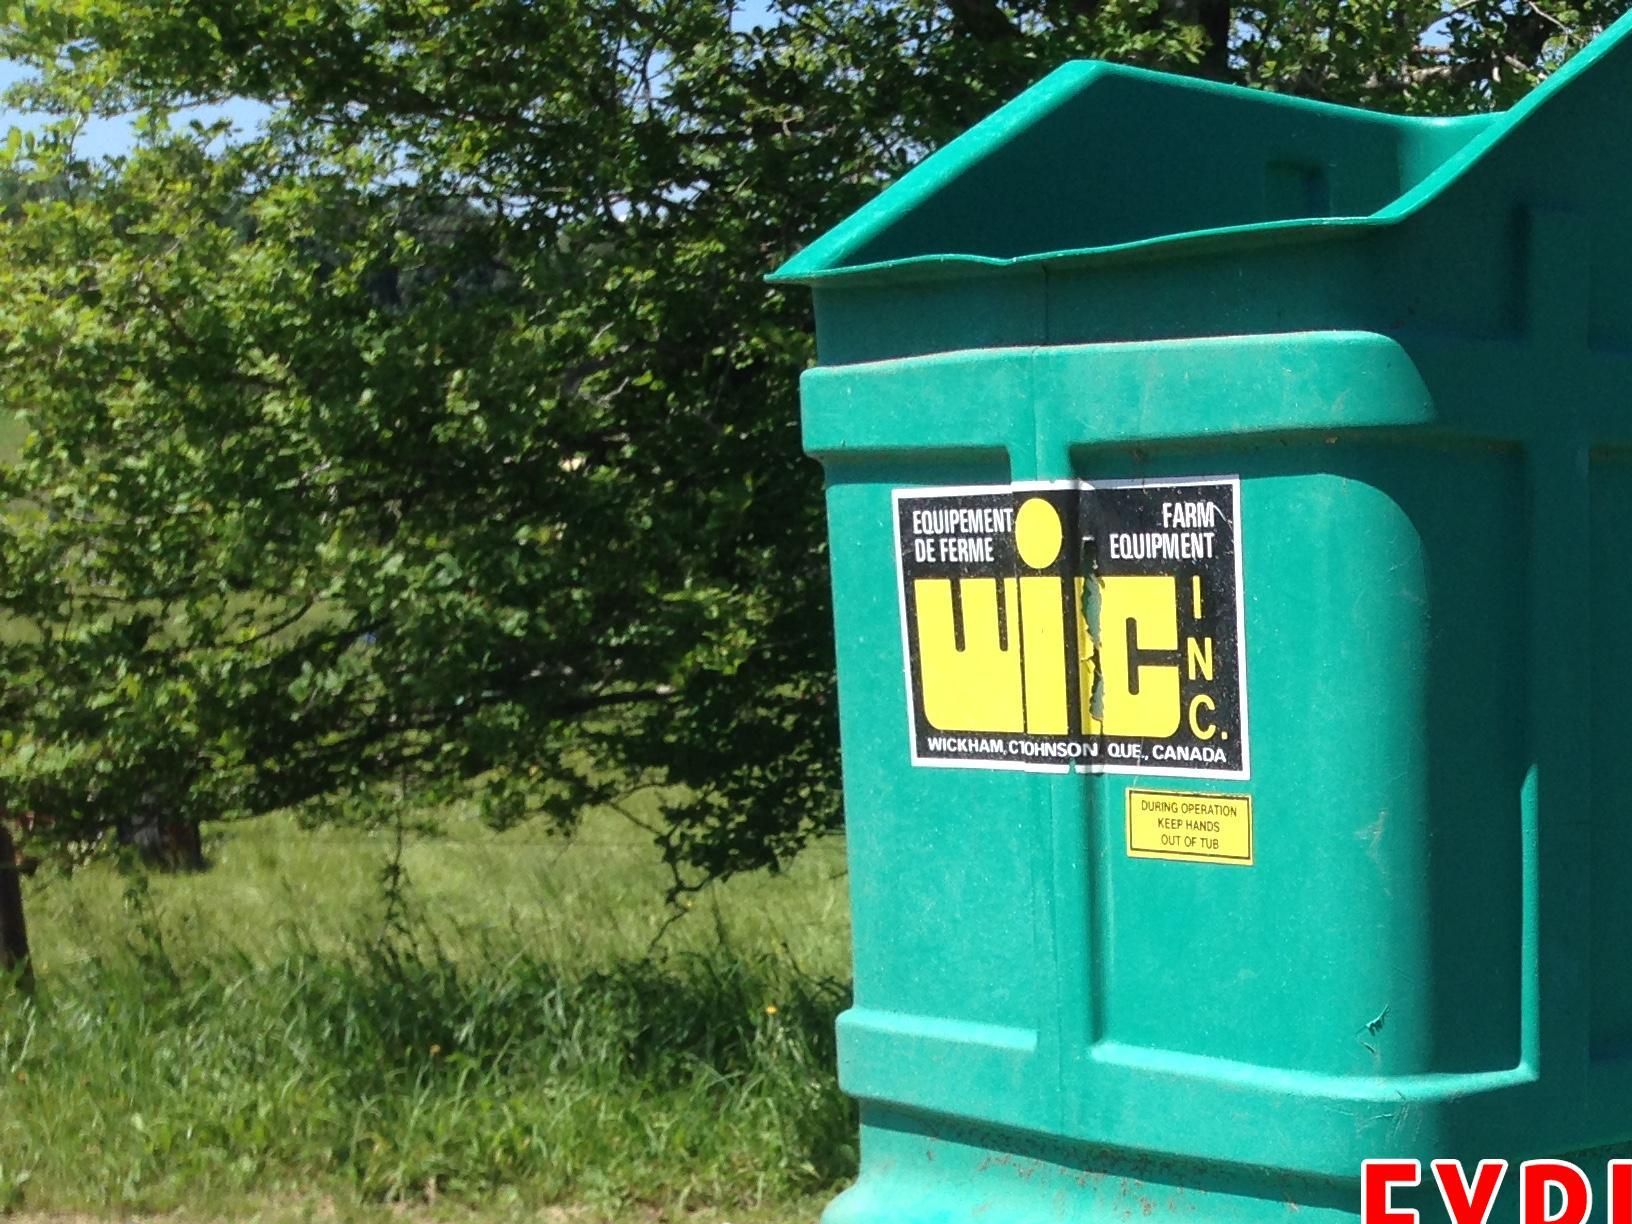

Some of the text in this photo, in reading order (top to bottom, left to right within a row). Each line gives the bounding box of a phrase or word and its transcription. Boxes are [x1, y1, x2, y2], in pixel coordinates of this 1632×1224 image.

[912, 508, 1013, 534] EQUIPEMENT
[1162, 502, 1216, 529] FARM
[914, 537, 995, 563] DE FERME
[1109, 532, 1215, 560] EQUIPMENT
[927, 736, 1006, 755] WICKHAM,
[1152, 744, 1228, 763] CANADA
[1141, 800, 1238, 817] DURING OPERATION
[1157, 817, 1221, 833] KEEP HANDS
[1160, 834, 1219, 849] OUT OF TUB
